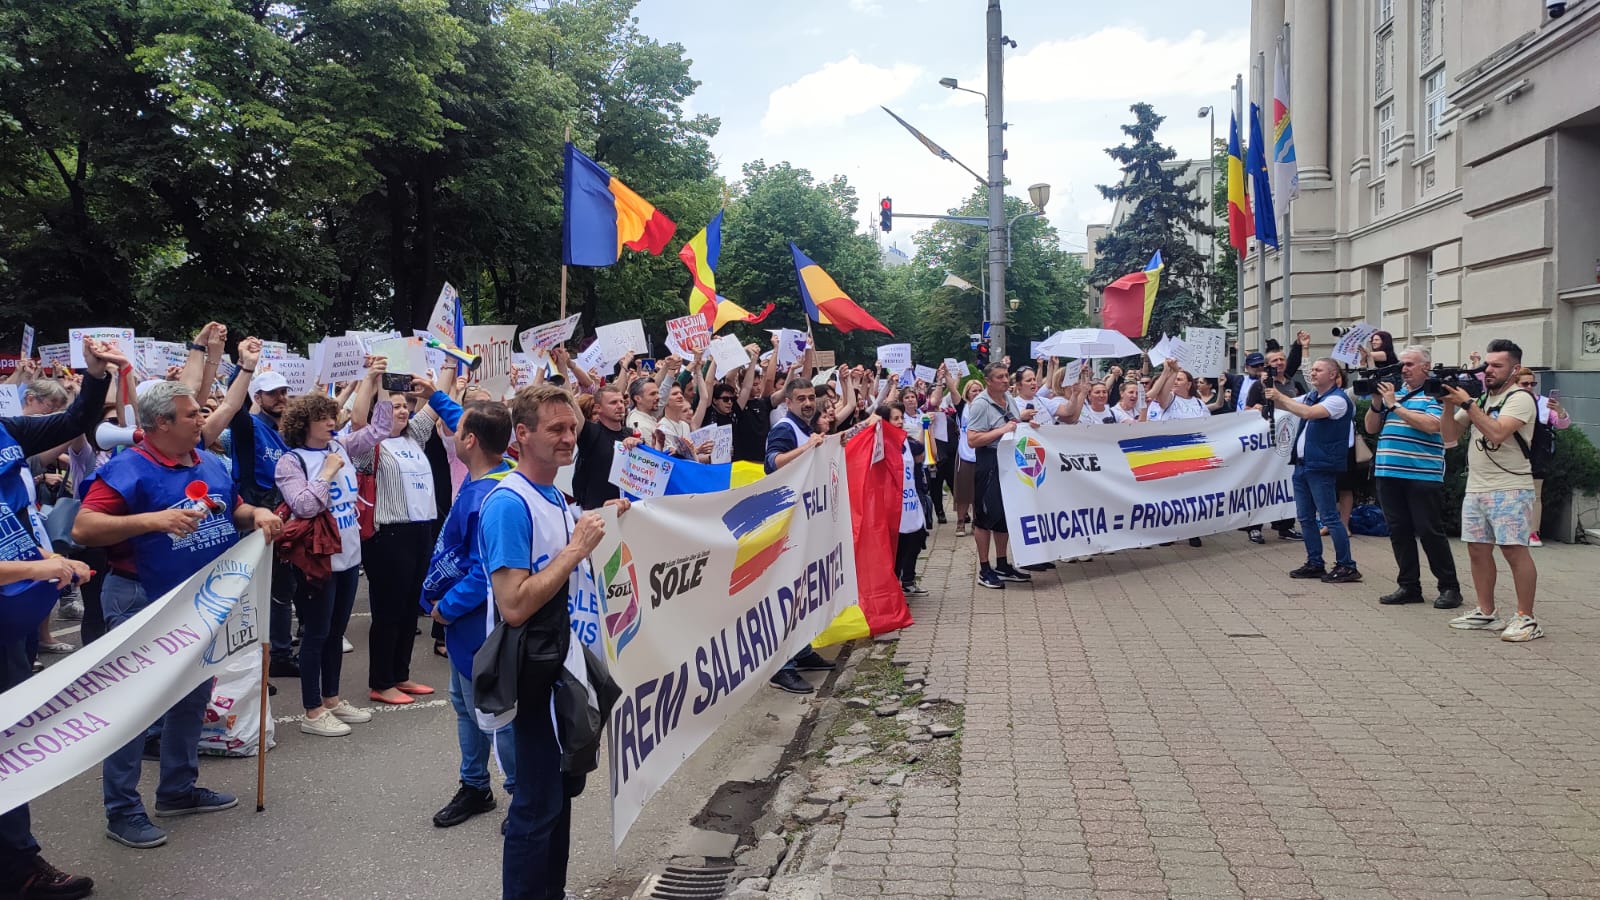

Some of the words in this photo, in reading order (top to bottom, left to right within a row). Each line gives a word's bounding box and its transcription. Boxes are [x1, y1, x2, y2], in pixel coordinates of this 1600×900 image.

[1059, 453, 1101, 472] SOLE
[803, 484, 827, 520] FSLI
[1020, 506, 1108, 546] EDUCAȚIA
[1130, 491, 1226, 530] PRIORITATE
[1228, 479, 1294, 518] NAȚIONAL
[650, 557, 709, 609] SOLE
[232, 625, 254, 647] UPT
[693, 596, 778, 715] SALARII
[3, 645, 156, 738] OLITEHNICA"
[153, 624, 201, 656] DIN
